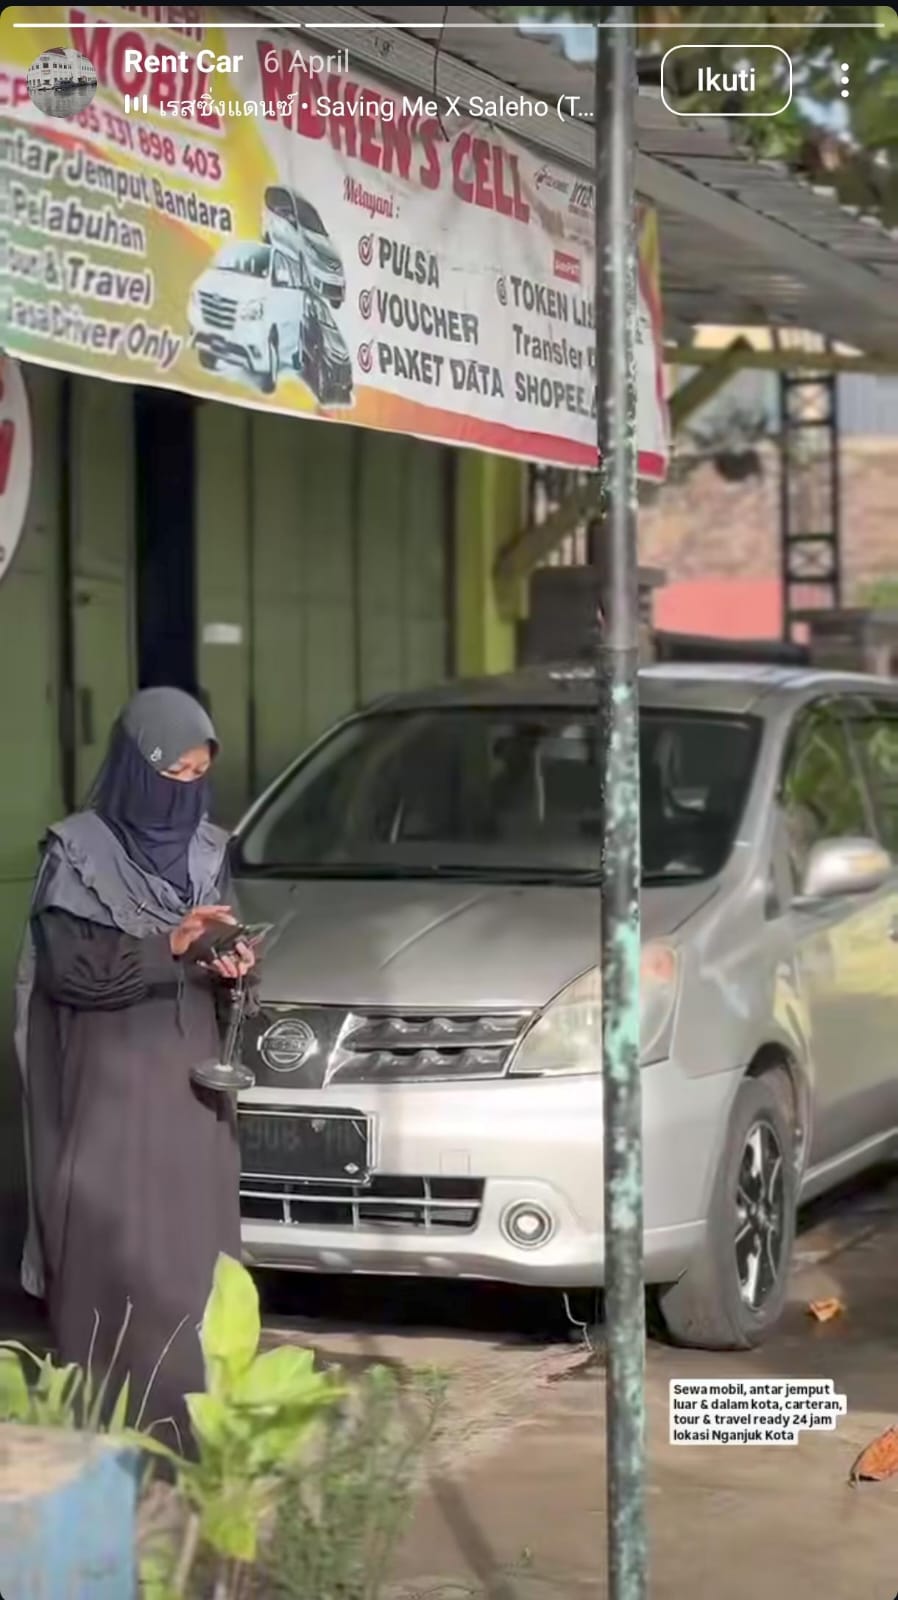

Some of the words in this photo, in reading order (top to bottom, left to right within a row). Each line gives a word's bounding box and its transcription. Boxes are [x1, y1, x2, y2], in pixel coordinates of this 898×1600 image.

[139, 126, 176, 166] 898
[182, 143, 222, 181] 403
[451, 131, 530, 224] CELL
[66, 148, 149, 204] Jemput
[154, 180, 233, 232] Bandara
[343, 174, 394, 220] Melayani
[14, 186, 145, 252] Pelabuhan
[68, 257, 151, 306] Travel
[378, 235, 440, 289] PULSA
[377, 288, 479, 345] VOUCHER
[510, 275, 569, 323] TOKEN
[128, 322, 181, 369] Only
[377, 342, 444, 387] PAKET
[450, 358, 505, 399] DATA
[512, 323, 584, 370] Transfer
